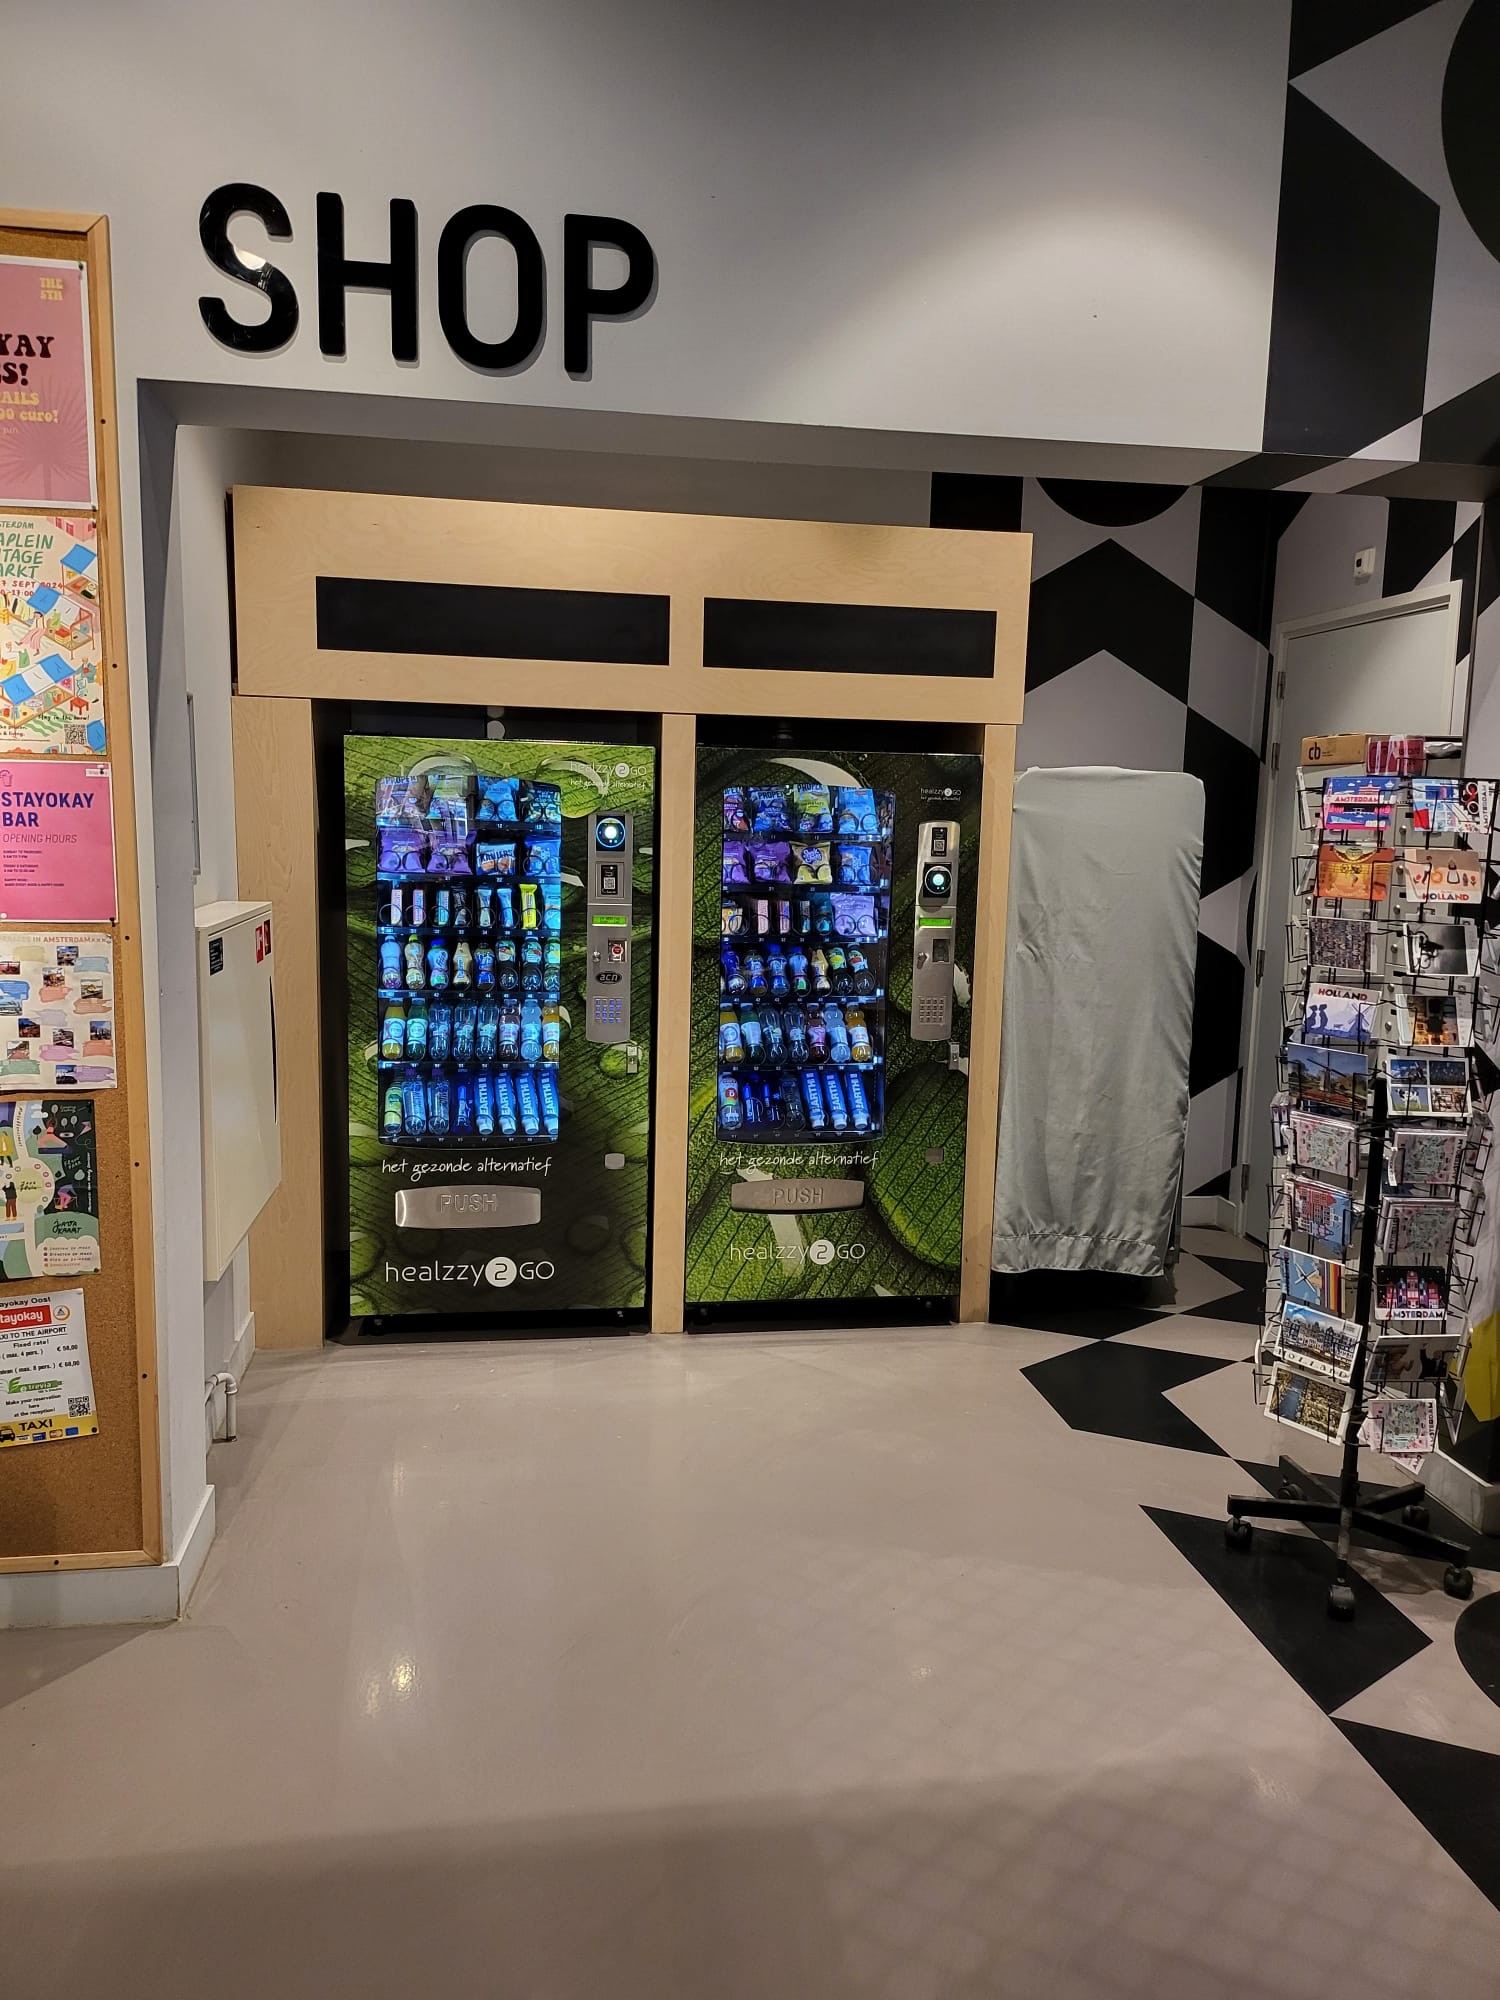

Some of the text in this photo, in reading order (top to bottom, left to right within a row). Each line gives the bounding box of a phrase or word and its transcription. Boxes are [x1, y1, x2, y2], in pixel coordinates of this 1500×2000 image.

[199, 182, 655, 376] SHOP
[1308, 741, 1321, 760] cb
[1, 792, 94, 809] STAYOKAY
[3, 812, 39, 827] BAR
[2, 834, 78, 844] OPENING HOURS
[1422, 892, 1470, 901] HOLLAND
[599, 972, 619, 982] acn
[1318, 988, 1368, 1001] HOLLAND
[478, 1083, 489, 1115] EARTH
[498, 1083, 511, 1115] EARTH
[520, 1083, 533, 1115] EARTH
[542, 1083, 556, 1115] EARTH
[382, 1156, 553, 1182] het gezonde alternatief
[719, 1151, 880, 1175] het gezonde alternatief
[440, 1194, 498, 1214] PUSH
[773, 1187, 824, 1205] PUSH
[730, 1239, 866, 1266] healzzy2GO
[385, 1256, 555, 1288] healzzy2GO
[1386, 1310, 1443, 1319] AMSTERDAM
[19, 1419, 53, 1431] TAXI
